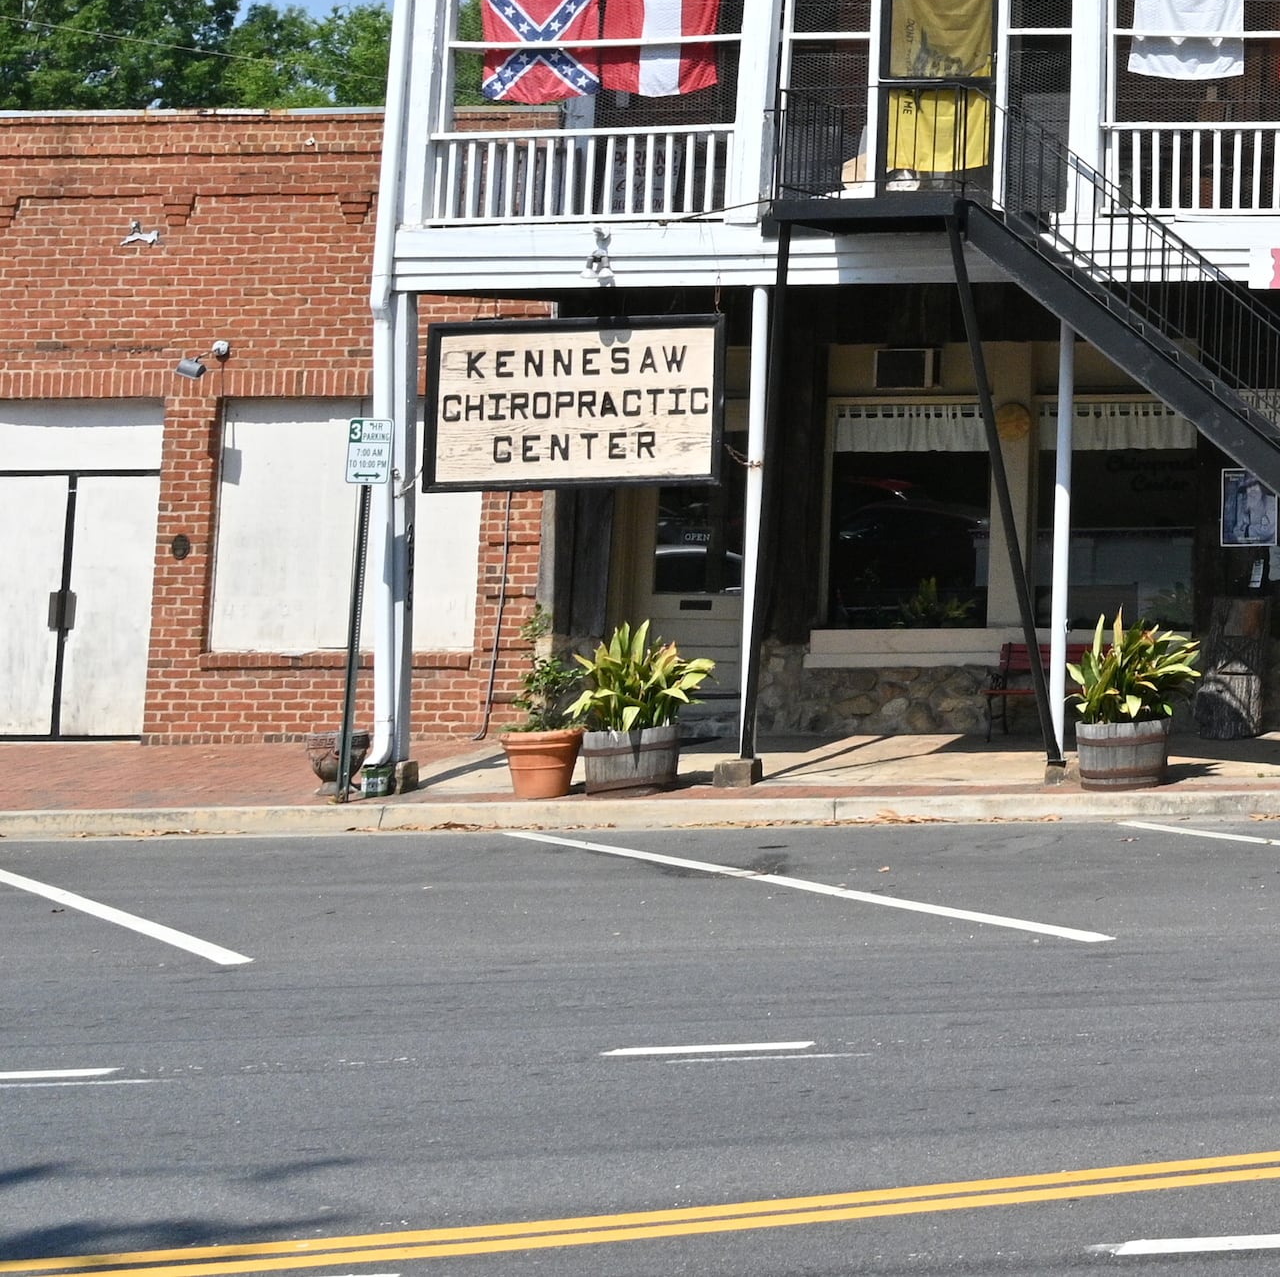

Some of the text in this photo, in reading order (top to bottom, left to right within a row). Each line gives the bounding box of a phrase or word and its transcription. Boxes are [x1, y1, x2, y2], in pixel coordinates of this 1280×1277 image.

[903, 100, 913, 115] ME
[467, 345, 687, 378] KENNESAW
[442, 387, 709, 422] CHIROPRACTIC
[351, 423, 361, 440] 3
[363, 433, 390, 441] PARKING
[356, 448, 383, 457] 7:00 AM
[493, 431, 656, 463] CENTER
[350, 459, 387, 468] TO 10:00 PM
[684, 532, 711, 542] OPEN
